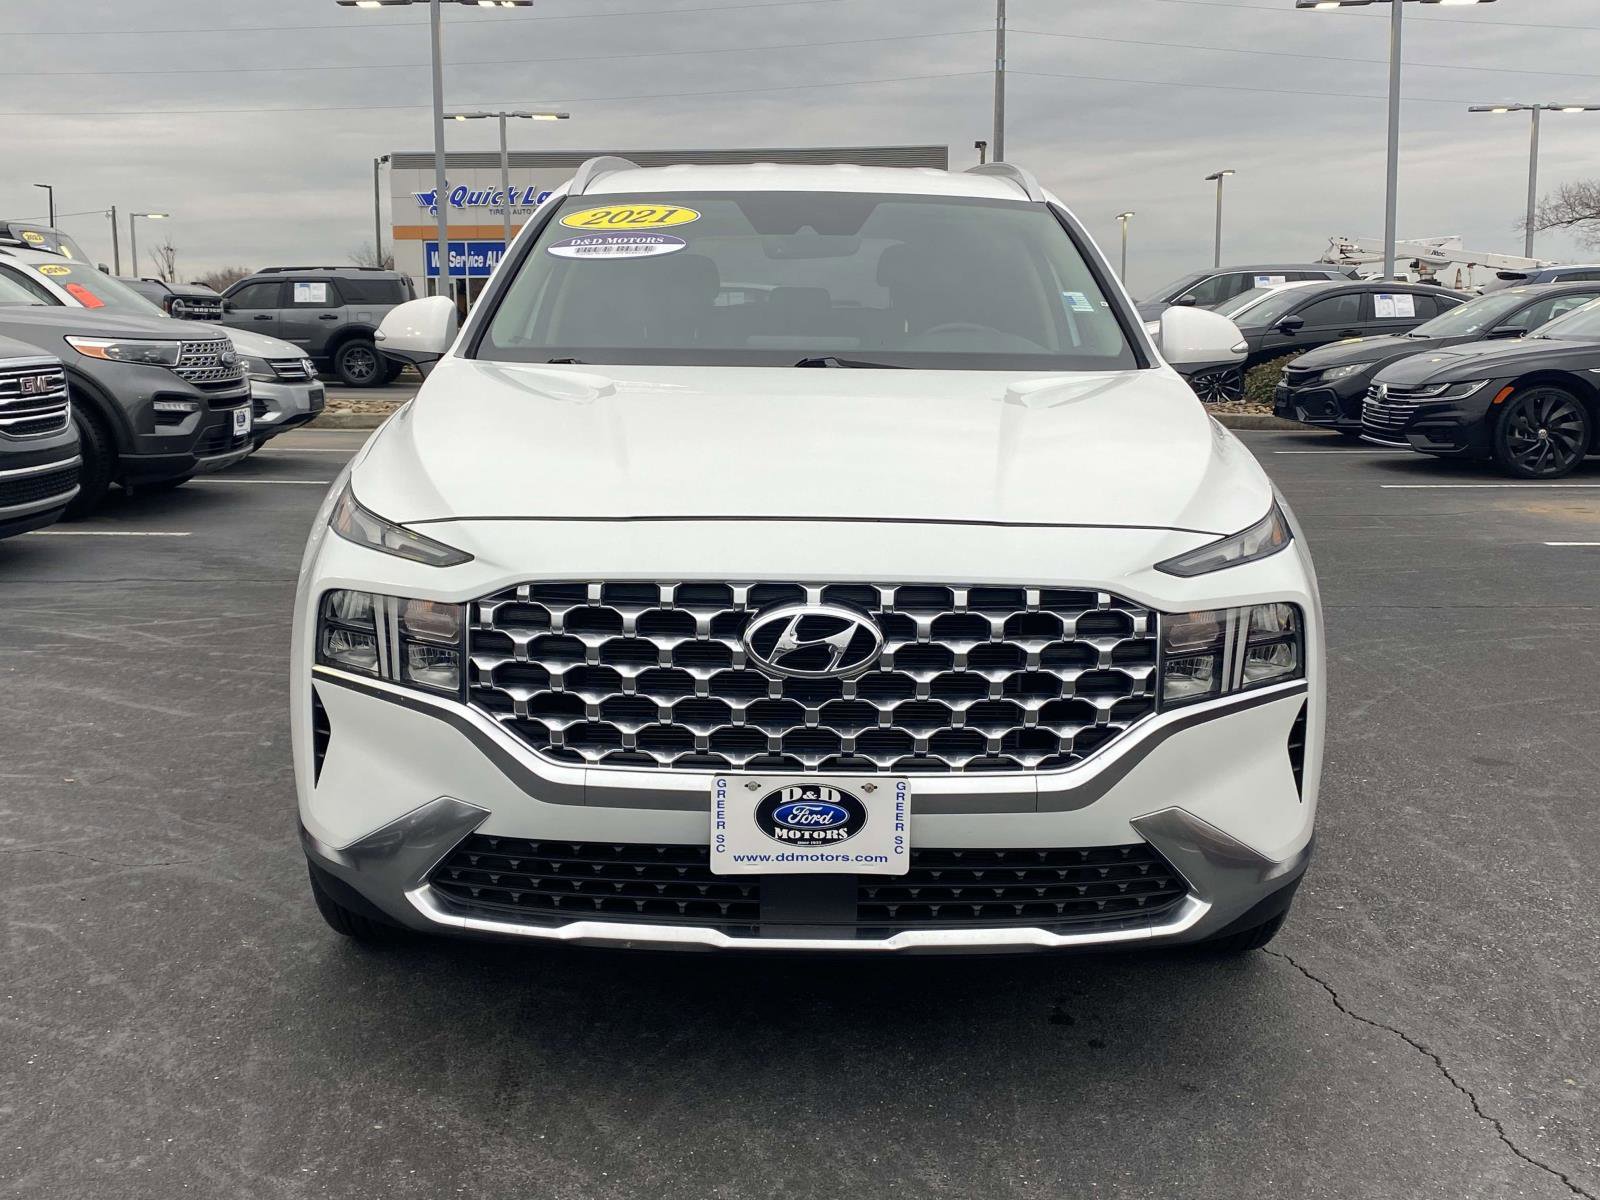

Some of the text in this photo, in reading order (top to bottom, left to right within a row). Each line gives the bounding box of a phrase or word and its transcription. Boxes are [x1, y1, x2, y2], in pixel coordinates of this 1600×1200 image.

[449, 185, 520, 208] Quick
[512, 208, 531, 216] AUTO
[581, 208, 680, 226] 2021
[570, 236, 665, 246] D&D MOTORS
[449, 251, 484, 267] Service
[20, 376, 54, 395] GMC
[780, 786, 841, 803] D&D
[716, 778, 727, 853] GREER SC
[787, 805, 834, 824] Ford
[894, 781, 906, 854] GREER SC
[774, 827, 848, 839] MOTORS
[733, 852, 888, 863] www.ddmotors.com
